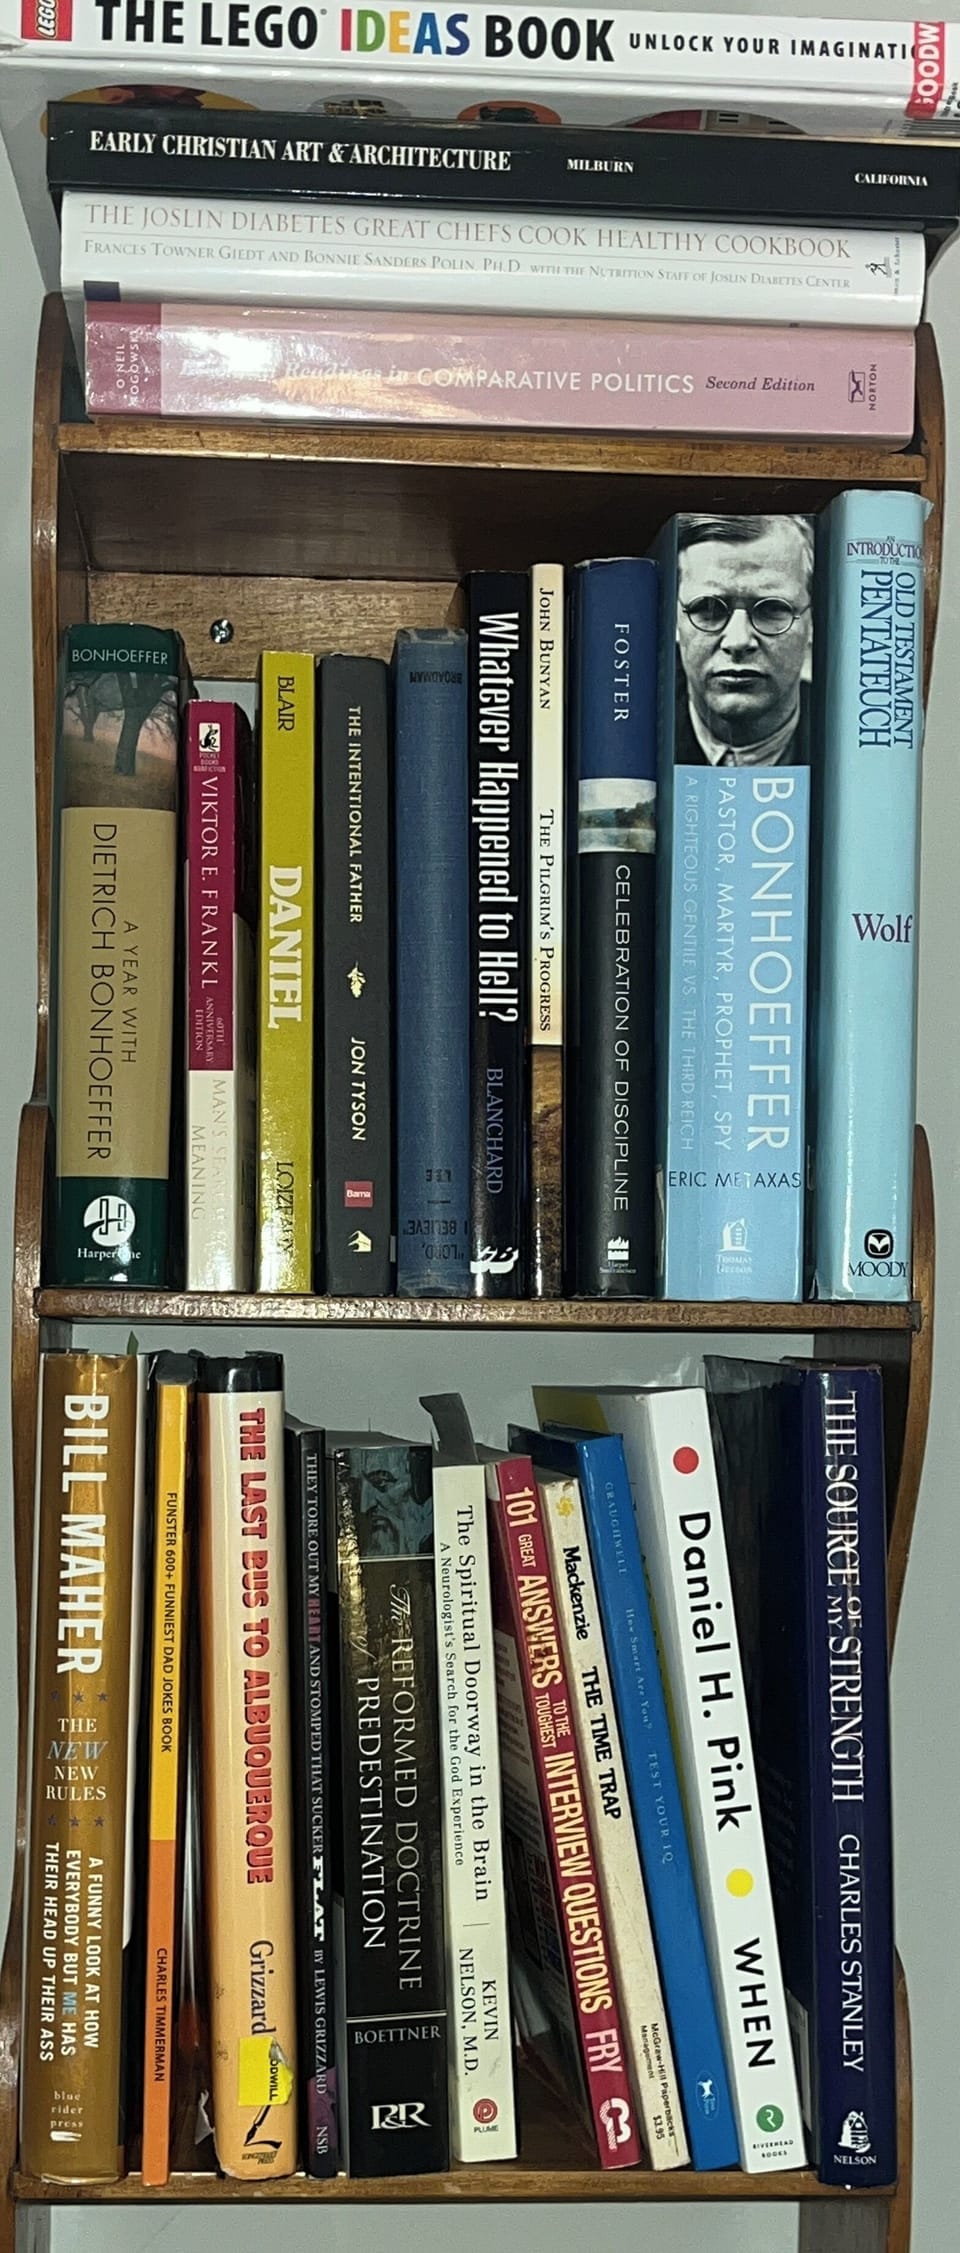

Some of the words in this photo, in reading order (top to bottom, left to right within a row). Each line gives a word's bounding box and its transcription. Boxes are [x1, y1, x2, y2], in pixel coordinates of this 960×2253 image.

[94, 0, 184, 44] THE
[201, 3, 319, 50] LEGO
[340, 8, 471, 56] IDEAS
[484, 14, 616, 62] BOOK
[629, 32, 715, 53] UNLOCK
[723, 36, 781, 56] YOUR
[89, 130, 157, 154] EARLY
[161, 133, 277, 161] CHRISTIAN
[281, 141, 324, 164] ART
[349, 143, 511, 171] ARCHITECTURE
[567, 157, 634, 173] MILBURN
[854, 172, 929, 187] CALIFORNIA
[84, 203, 135, 227] THE
[142, 206, 224, 230] JOSLIN
[231, 210, 346, 236] DIABETES
[353, 215, 432, 241] GREAT
[436, 219, 512, 244] CHEFS
[517, 224, 588, 248] COOK
[597, 228, 706, 253] HEALTHY
[714, 233, 852, 260] COOKBOOK
[416, 366, 582, 391] COMPARATIVE
[591, 371, 695, 395] POLITICS
[705, 376, 758, 393] Second
[761, 377, 816, 393] Edition
[868, 362, 878, 412] NORTON
[895, 571, 916, 618] OLD
[71, 648, 168, 666] BONHOEFFER
[479, 611, 519, 752] Whatever
[613, 623, 630, 722] FOSTER
[859, 569, 893, 749] PENTATEUCH
[278, 676, 295, 732] BLAIR
[892, 622, 916, 749] TESTAMENT
[347, 706, 361, 737] THE
[201, 779, 219, 857] VIKTOR
[348, 743, 362, 857] INTENTIONAL
[715, 777, 737, 872] PASTOR,
[471, 761, 519, 903] Happened
[92, 824, 118, 950] DIETRICH
[349, 863, 363, 922] FATHER
[201, 889, 219, 989] FRANKL
[267, 864, 303, 1028] DANIEL
[614, 864, 631, 1030] CELEBRATION
[711, 884, 736, 981] MARTYR,
[852, 913, 913, 943] Wolf
[122, 945, 138, 995] YEAR
[478, 950, 519, 1023] Hell?
[746, 777, 795, 1151] BONHOEFFER
[120, 1007, 137, 1063] WITH
[195, 1008, 205, 1051] EDITION
[205, 996, 216, 1063] ANNIVERSARY
[216, 1016, 226, 1043] 60TH
[350, 1037, 365, 1075] JON
[614, 1040, 631, 1071] OF
[711, 992, 735, 1098] PROPHET,
[87, 964, 115, 1159] BONHOEFFER
[350, 1081, 367, 1141] TYSON
[485, 1067, 504, 1194] BLANCHARD
[713, 1111, 733, 1151] SPY
[191, 1125, 206, 1220] MEANING
[613, 1080, 630, 1211] DISCIPLINE
[668, 1170, 707, 1188] ERIC
[714, 1171, 802, 1189] METAXAS
[848, 1261, 909, 1278] MOODY
[62, 1394, 110, 1492] BILL
[239, 1407, 266, 1461] THE
[824, 1390, 859, 1457] THE
[306, 1453, 320, 1494] THEY
[163, 1492, 178, 1547] FUNSTER
[240, 1472, 268, 1539] LAST
[306, 1496, 321, 1538] TORE
[455, 1504, 475, 1546] The
[504, 1486, 539, 1527] 101
[825, 1464, 862, 1586] SOURCE
[306, 1540, 321, 1572] OUT
[517, 1534, 538, 1568] GREAT
[56, 1513, 107, 1675] MAHER
[241, 1550, 270, 1609] BUS
[306, 1573, 321, 1598] MY
[439, 1557, 459, 1648] Neurologist's
[456, 1554, 480, 1651] Spiritual
[562, 1545, 591, 1640] Mackenzie
[678, 1511, 731, 1654] Daniel
[161, 1583, 176, 1642] FUNNIEST
[243, 1618, 270, 1658] TO
[307, 1600, 322, 1644] HEART
[516, 1574, 562, 1689] ANSWERS
[827, 1595, 843, 1628] MY
[309, 1679, 323, 1749] STOMPED
[446, 1704, 461, 1725] for
[461, 1659, 485, 1757] Doorway
[580, 1665, 605, 1709] THE
[698, 1671, 734, 1718] H.
[57, 1717, 98, 1733] THE
[391, 1638, 419, 1808] REFORMED
[448, 1728, 462, 1751] the
[532, 1692, 557, 1749] TOUGHEST
[588, 1713, 614, 1763] TIME
[829, 1635, 865, 1802] STRENGTH
[47, 1740, 109, 1760] NEW
[54, 1765, 99, 1781] NEW
[243, 1669, 275, 1884] ALBUQUERQUE
[310, 1754, 324, 1794] THAT
[449, 1755, 464, 1783] God
[647, 1752, 662, 1789] TEST
[46, 1784, 107, 1801] RULES
[470, 1795, 488, 1830] the
[596, 1767, 622, 1820] TRAP
[707, 1736, 752, 1833] Pink
[311, 1796, 325, 1854] SUCKER
[357, 1677, 386, 1949] PREDESTINATION
[449, 1788, 466, 1866] Experience
[543, 1751, 593, 1878] INTERVIEW
[654, 1795, 671, 1838] YOUR
[44, 1842, 61, 1890] THEIR
[473, 1839, 492, 1901] Brain
[661, 1844, 675, 1865] IQ
[42, 1896, 59, 1940] HEAD
[63, 1850, 82, 1945] EVERYBODY
[86, 1874, 104, 1928] FUNNY
[312, 1854, 326, 1942] FLAT
[394, 1821, 424, 1990] DOCTRINE
[838, 1834, 863, 1954] CHARLES
[84, 1935, 102, 1977] LOOK
[154, 1948, 168, 2002] CHARLES
[560, 1884, 614, 2014] QUESTIONS
[41, 1975, 57, 2021] THEIR
[247, 1940, 279, 2035] Grizzard
[313, 1968, 327, 2014] LEWIS
[458, 1948, 479, 2029] NELSON,
[481, 1979, 501, 2041] KEVIN
[733, 1937, 777, 2069] WHEN
[39, 2028, 56, 2061] ASS
[60, 2022, 77, 2056] HAS
[82, 2009, 100, 2047] HOW
[153, 2005, 168, 2081] TIMMERMAN
[354, 2025, 441, 2045] BOETTNER
[839, 1960, 864, 2073] STANLEY
[314, 2017, 328, 2094] GRIZZARD
[584, 2028, 623, 2074] FRY
[640, 2024, 656, 2080] Management
[54, 2090, 81, 2101] blue
[650, 2022, 669, 2081] McGraw-Hill
[660, 2081, 676, 2138] Paperbacks
[50, 2120, 83, 2129] press
[51, 2104, 83, 2115] rider
[473, 2125, 499, 2133] PLUME
[316, 2126, 329, 2154] NSB
[753, 2139, 794, 2150] RIVERHEAD
[761, 2150, 788, 2158] BOOKS
[833, 2154, 877, 2165] NELSON
